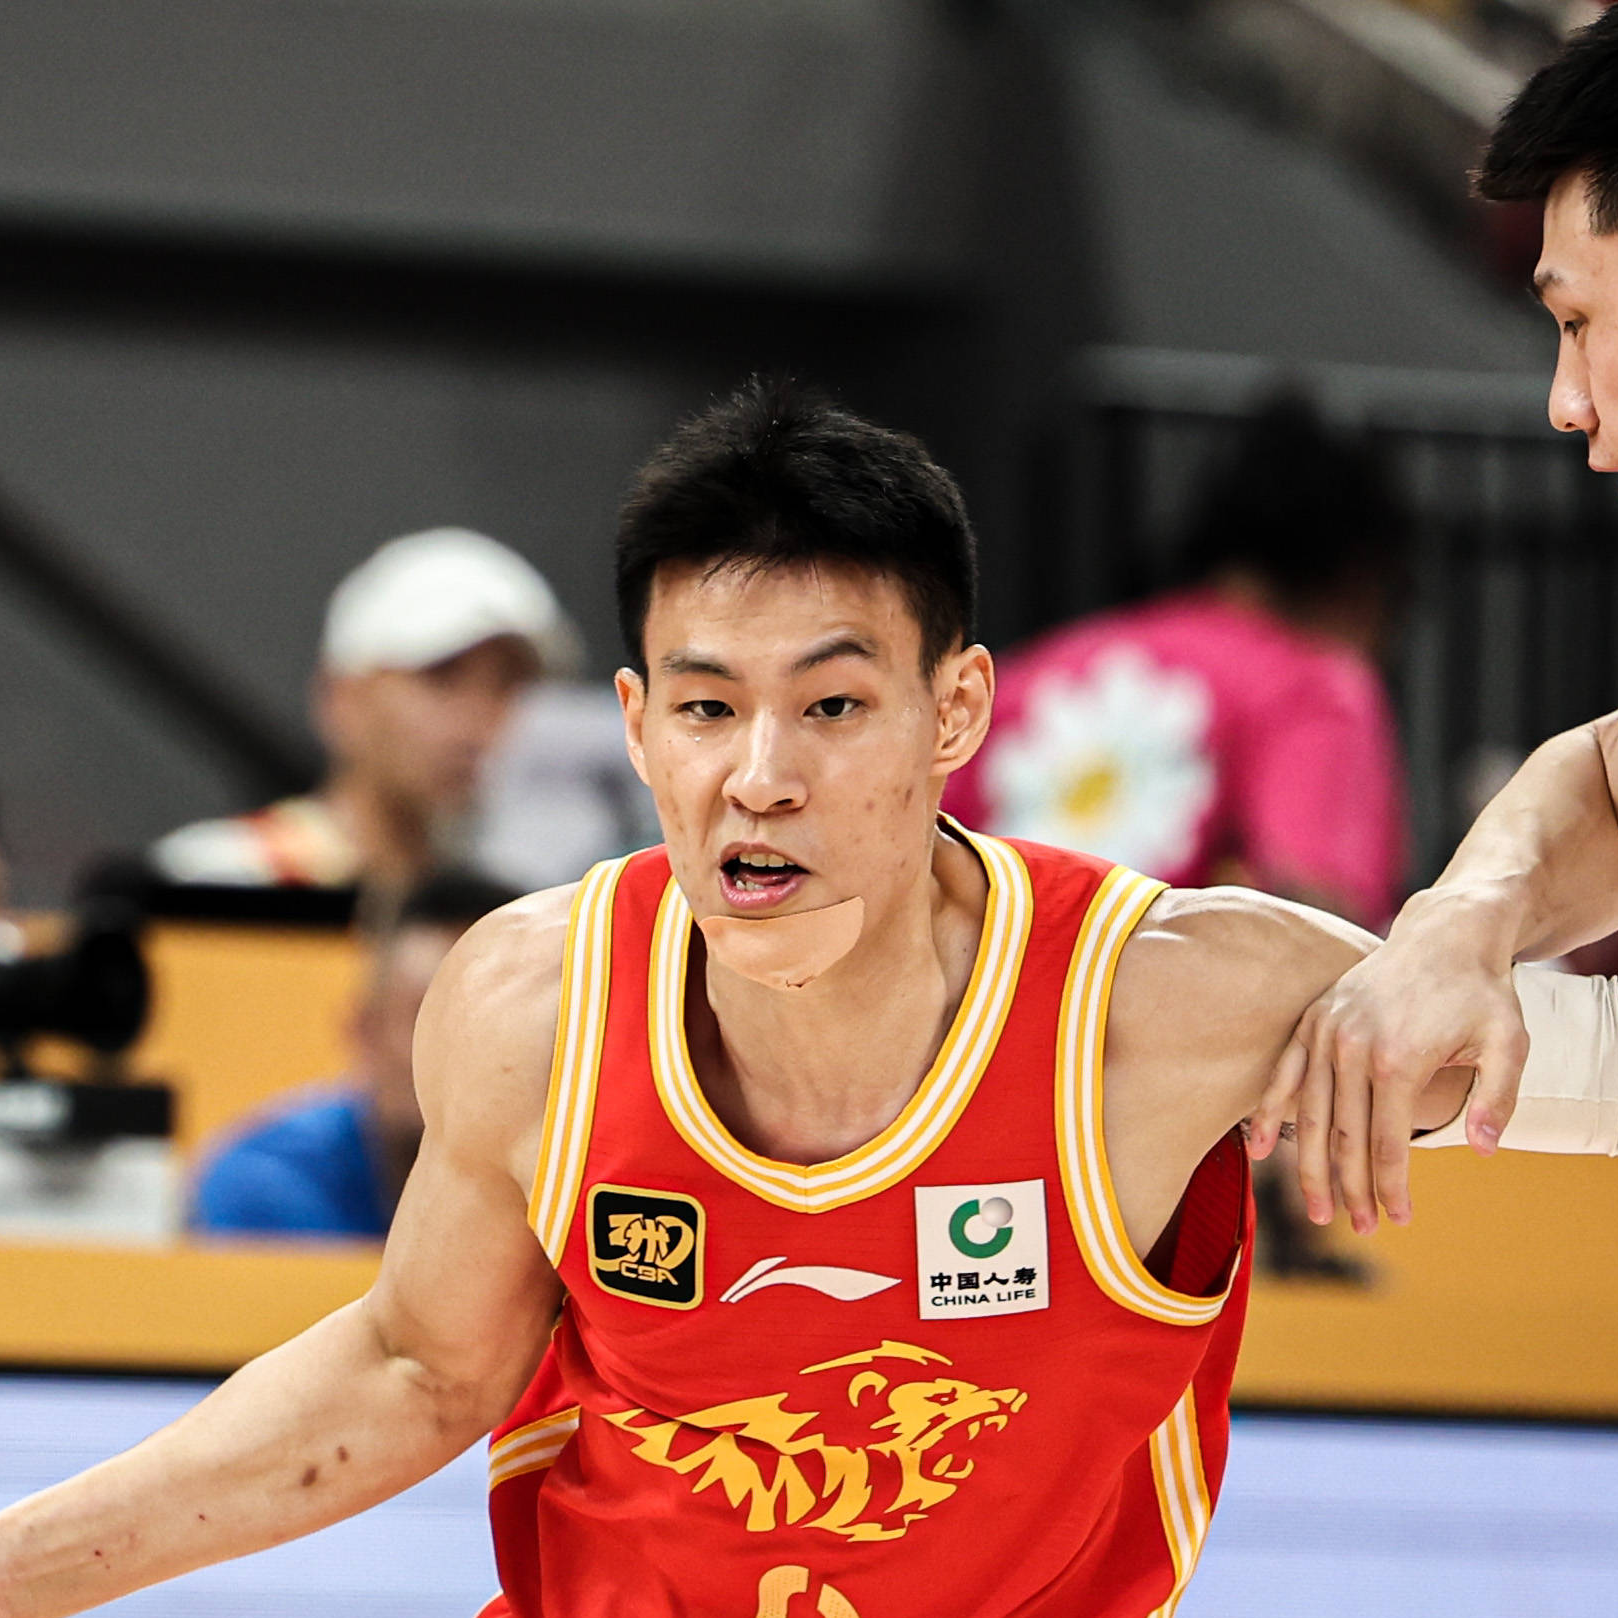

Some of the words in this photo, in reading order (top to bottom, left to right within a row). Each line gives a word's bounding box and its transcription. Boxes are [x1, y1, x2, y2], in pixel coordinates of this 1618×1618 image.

[620, 1260, 679, 1286] CBA
[930, 1267, 1037, 1292] 中国人寿
[931, 1294, 990, 1306] CHINA
[997, 1288, 1036, 1302] LIFE
